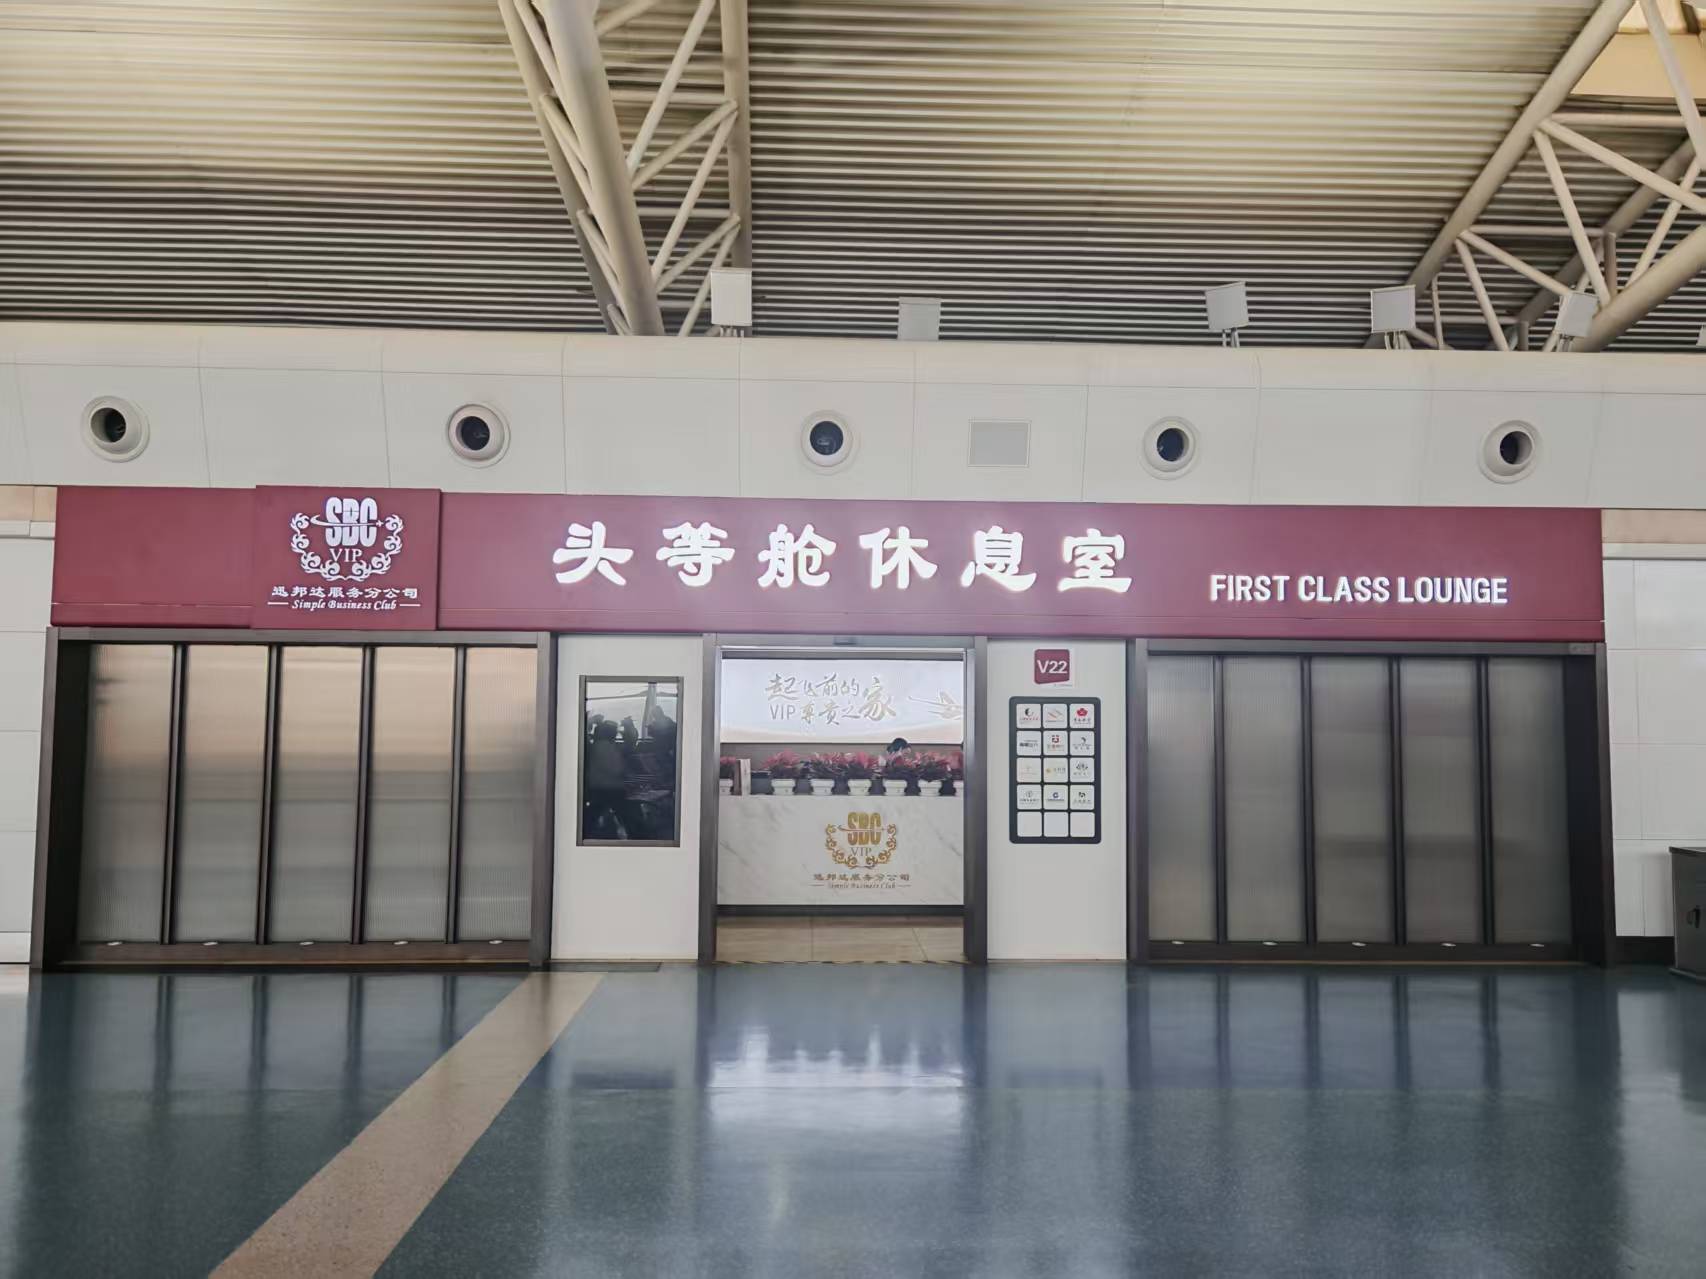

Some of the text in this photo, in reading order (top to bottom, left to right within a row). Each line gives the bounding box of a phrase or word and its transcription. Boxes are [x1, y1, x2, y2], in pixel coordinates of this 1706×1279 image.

[325, 497, 377, 547] SBC
[329, 548, 363, 563] VIP
[552, 520, 1133, 594] 头等舱休息室
[1210, 574, 1508, 604] FIRST CLASS LOUNGE
[292, 599, 397, 611] Simple Business Club
[1036, 659, 1068, 674] V22
